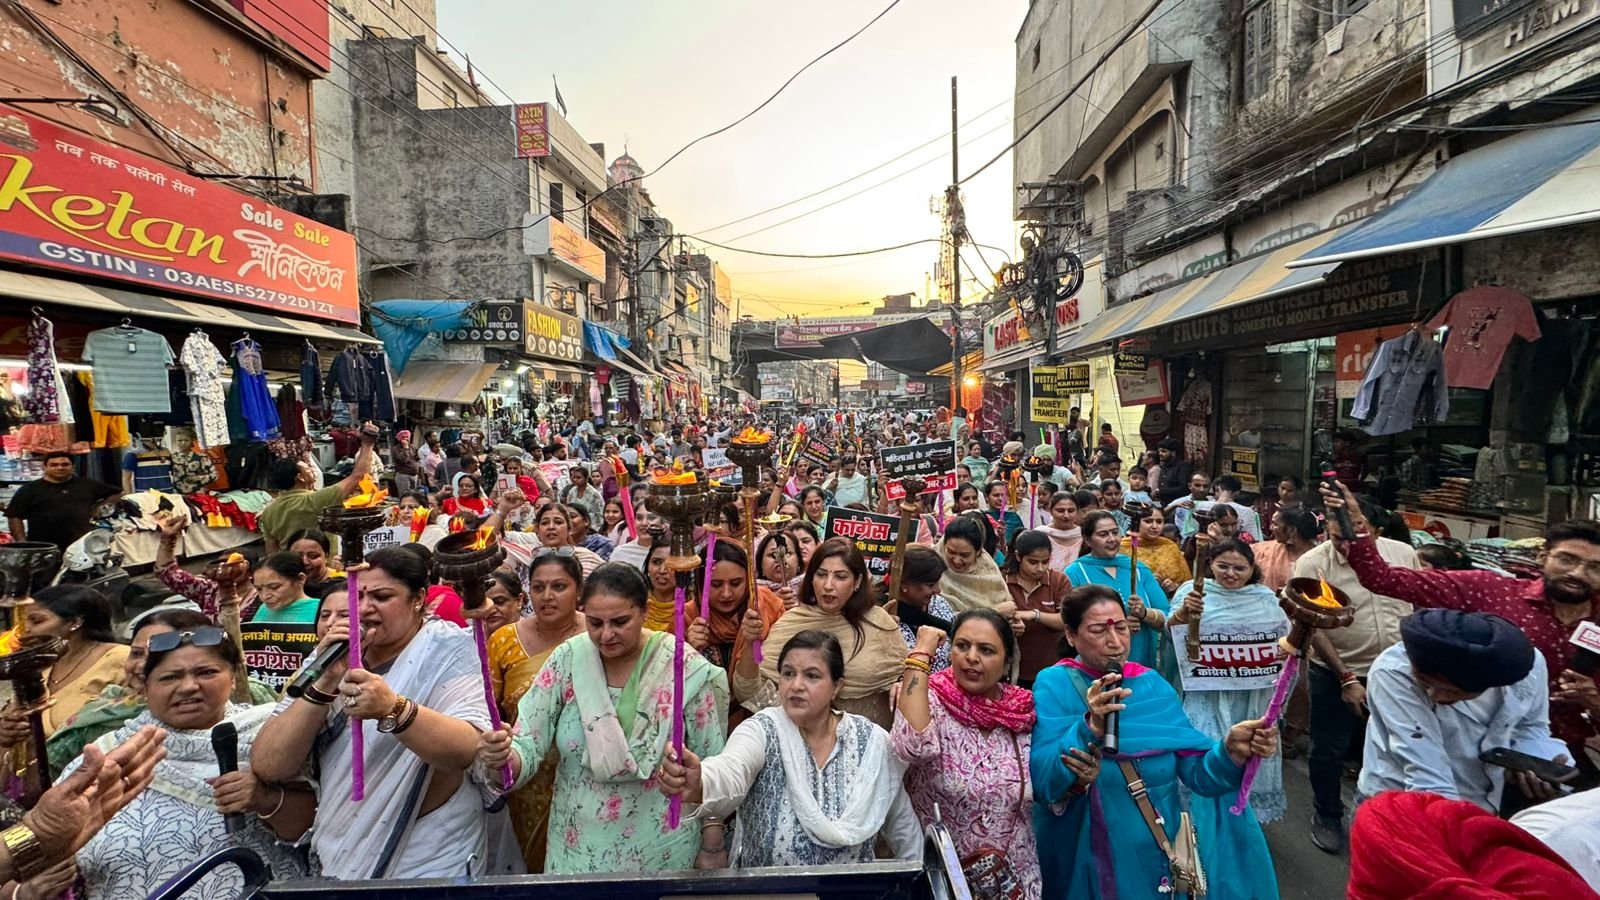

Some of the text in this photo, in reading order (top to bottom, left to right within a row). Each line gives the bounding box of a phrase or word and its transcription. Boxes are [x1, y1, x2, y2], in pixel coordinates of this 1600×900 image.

[55, 139, 196, 197] तब तक चलेगी सेल
[241, 202, 330, 247] Sale Sale
[39, 241, 137, 275] GSTIN
[163, 267, 335, 314] 03AESFS2792D1ZT
[1279, 289, 1321, 312] TICKET
[1323, 275, 1391, 301] BOOKING
[527, 309, 561, 340] FASHION
[1232, 290, 1409, 335] DOMESTIC MONEY TRANSFER
[1172, 314, 1230, 343] FRUITS
[1069, 366, 1089, 380] FRUITS
[1034, 409, 1068, 418] TRANSFER
[1038, 400, 1061, 408] MONEY
[833, 515, 892, 541] कांग्रेस
[271, 633, 284, 642] का
[286, 632, 319, 642] अपमा
[244, 645, 303, 670] कांग्रेस
[1197, 666, 1228, 677] कांग्रेस
[1229, 665, 1238, 678] है
